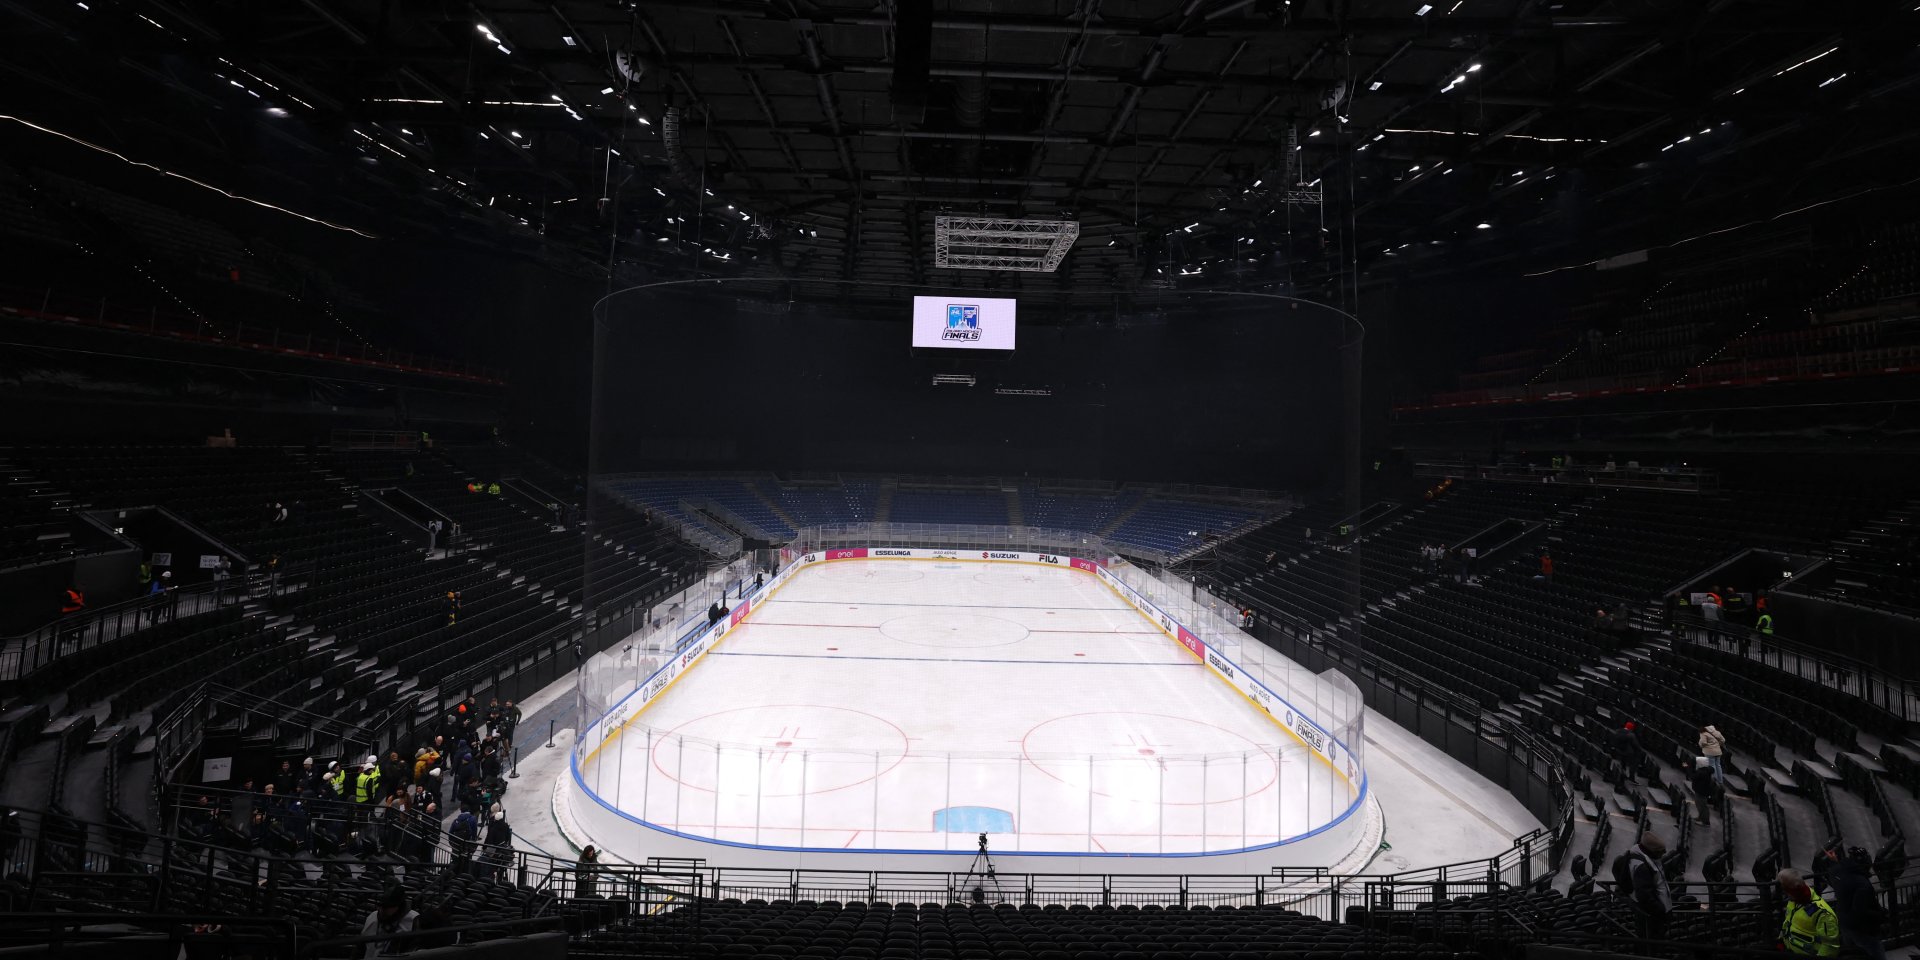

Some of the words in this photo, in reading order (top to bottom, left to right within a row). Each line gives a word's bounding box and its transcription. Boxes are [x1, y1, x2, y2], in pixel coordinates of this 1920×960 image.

[804, 554, 815, 564] FILA
[1038, 554, 1058, 563] FILA
[1080, 561, 1091, 571] enel
[713, 623, 725, 642] FILA
[1161, 615, 1171, 632] FILA
[687, 641, 705, 662] SUZUKI
[1209, 653, 1234, 679] ESSELUNGA
[1297, 723, 1322, 748] FINALS
